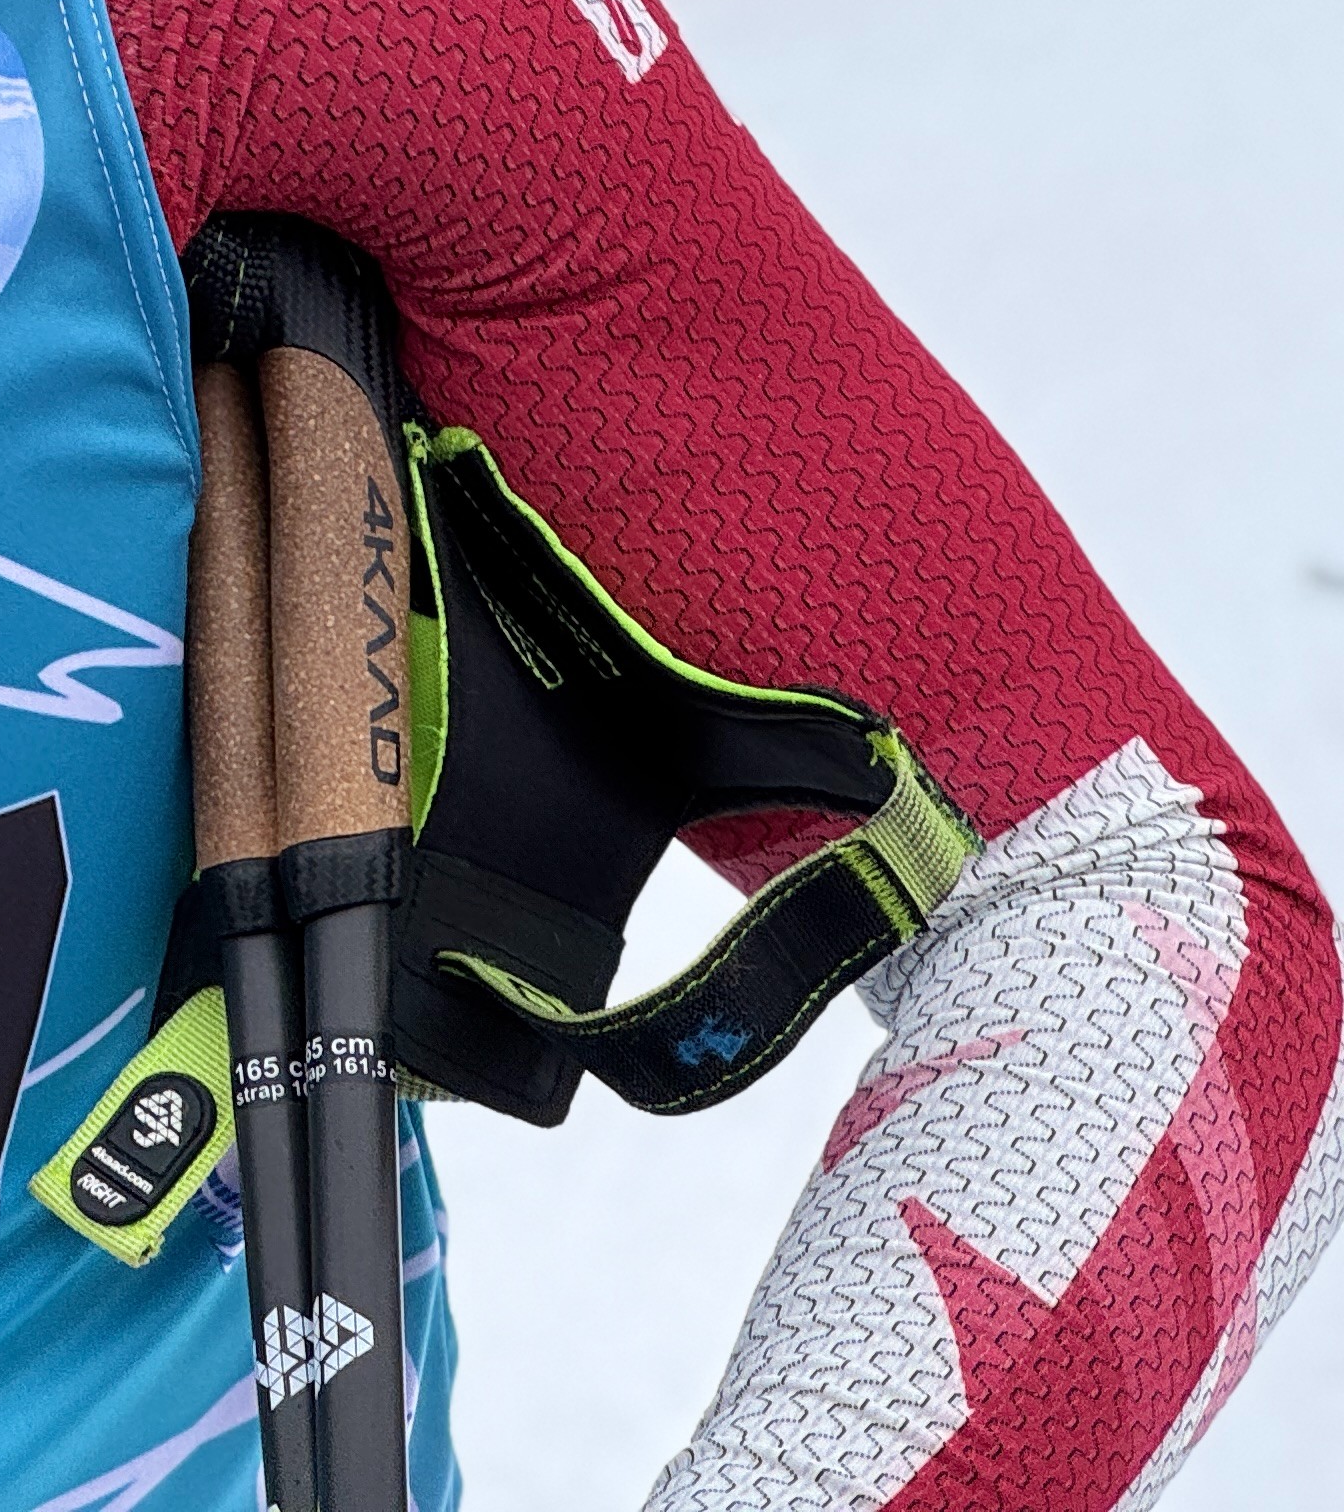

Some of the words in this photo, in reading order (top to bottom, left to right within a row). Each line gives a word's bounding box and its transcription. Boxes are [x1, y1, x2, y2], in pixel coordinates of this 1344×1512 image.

[331, 1037, 375, 1057] cm
[235, 1055, 280, 1085] 165
[289, 1060, 308, 1079] c
[333, 1057, 387, 1079] 161,5
[236, 1082, 285, 1107] strap
[77, 1172, 128, 1209] RIGHT
